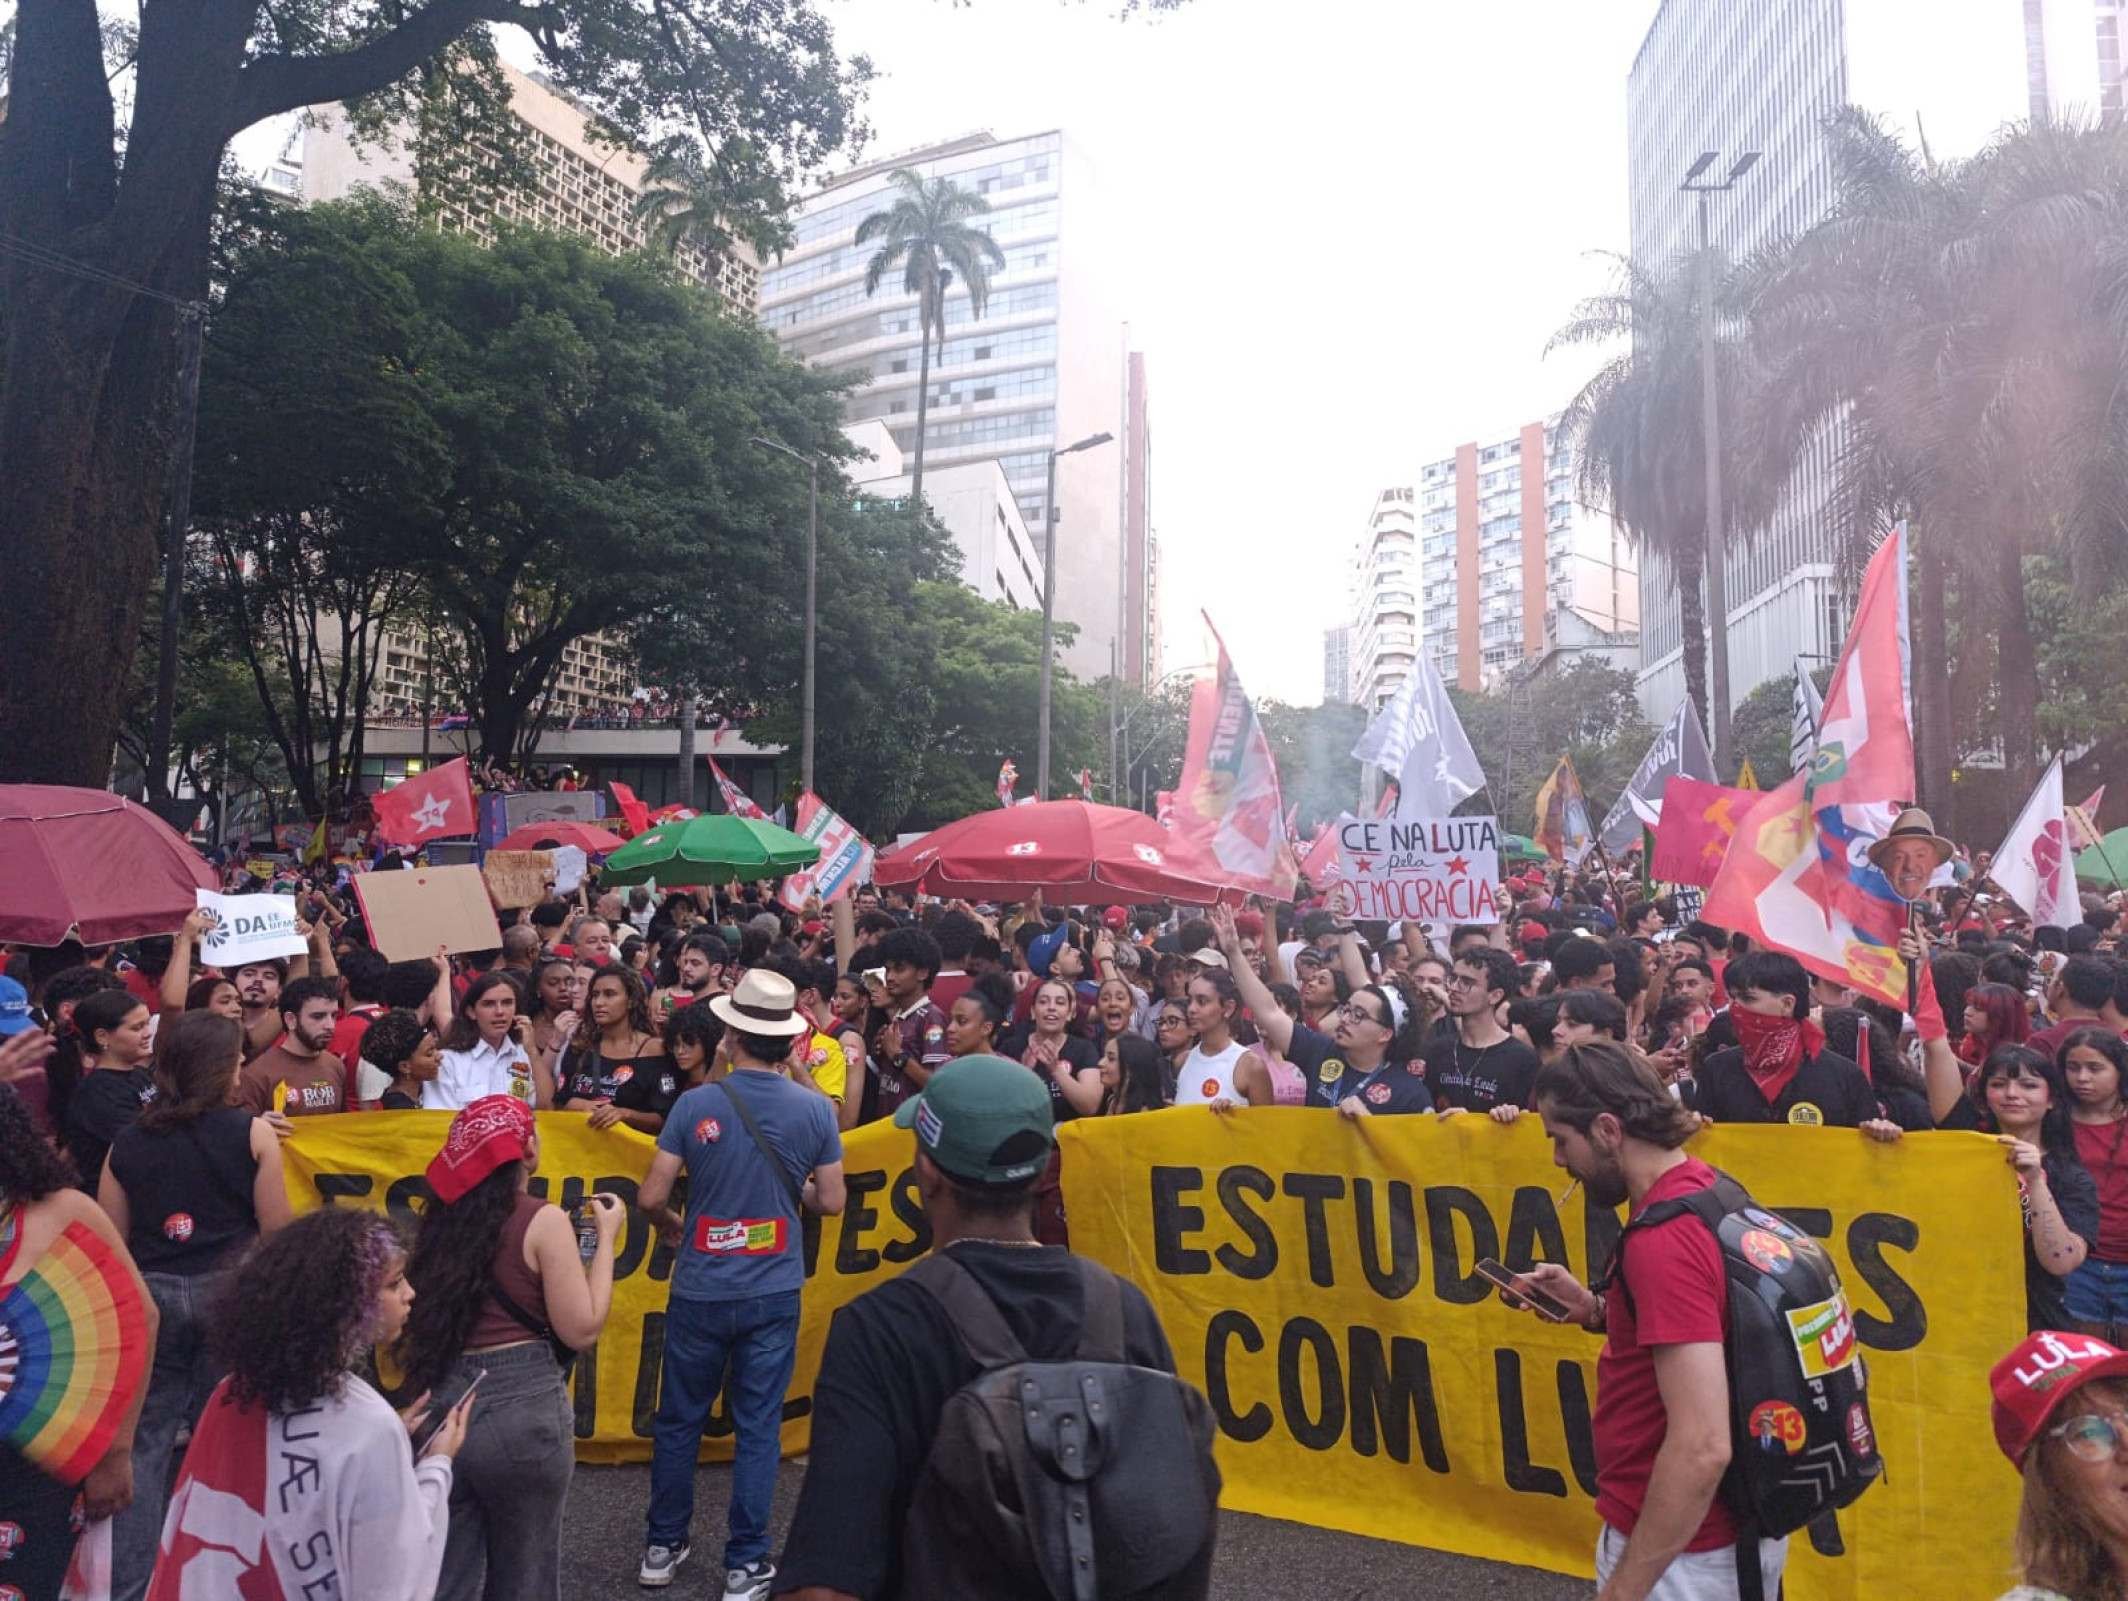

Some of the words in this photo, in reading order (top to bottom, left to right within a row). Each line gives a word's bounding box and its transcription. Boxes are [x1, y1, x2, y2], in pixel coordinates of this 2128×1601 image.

[1341, 823, 1382, 851] CE
[1391, 822, 1427, 852] NA
[1431, 822, 1498, 853] LUTA
[1377, 852, 1436, 877] pela
[1338, 879, 1498, 920] DEMOCRACIA
[235, 915, 267, 935] DA
[709, 1228, 746, 1243] LULA
[1151, 1165, 1926, 1351] ESTUDAS
[2013, 1340, 2113, 1387] LULA
[1205, 1310, 1450, 1474] COM
[1774, 1410, 1803, 1441] 13
[279, 1406, 324, 1514] UÆ
